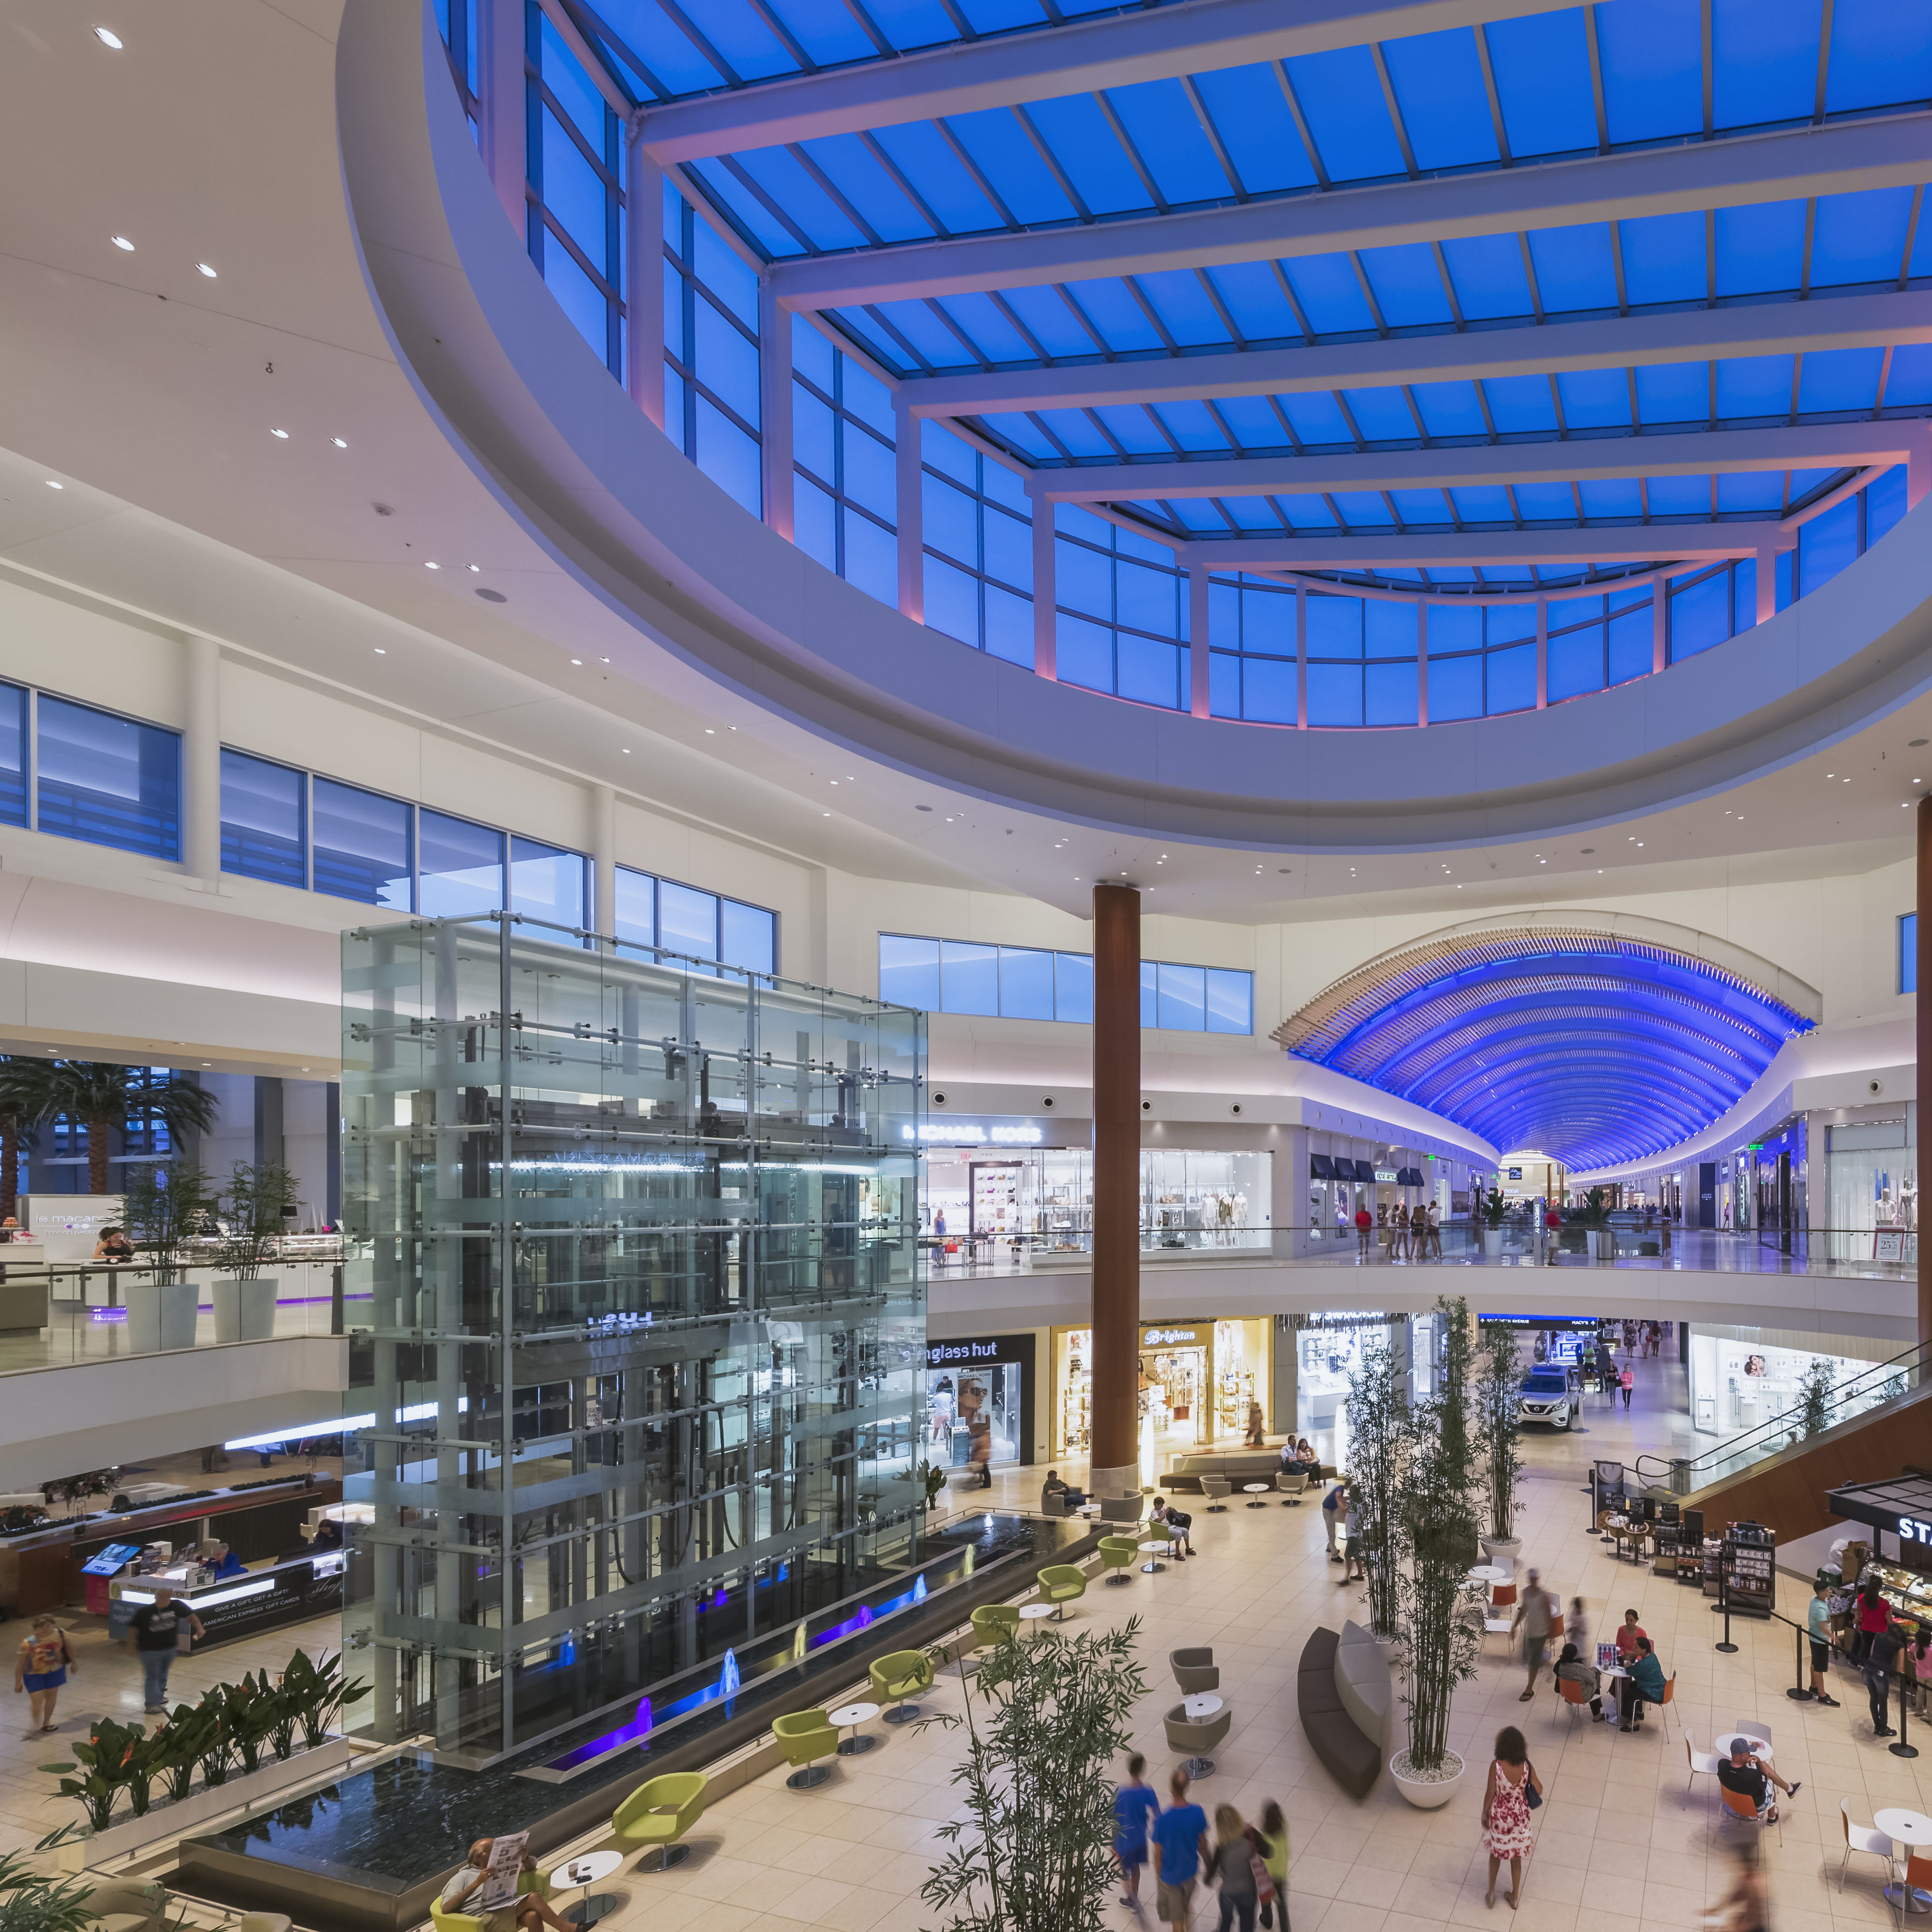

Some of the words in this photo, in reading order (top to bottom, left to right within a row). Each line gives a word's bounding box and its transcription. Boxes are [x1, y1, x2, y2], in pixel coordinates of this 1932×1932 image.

[992, 1127, 1041, 1142] KORS
[1144, 1329, 1196, 1344] Brighton
[972, 1342, 997, 1357] hut
[1899, 1518, 1932, 1545] ST
[203, 1614, 237, 1626] AMERICAN
[238, 1606, 263, 1617] EXPRESS
[280, 1596, 300, 1605] CARDS
[215, 1604, 230, 1613] GIVE
